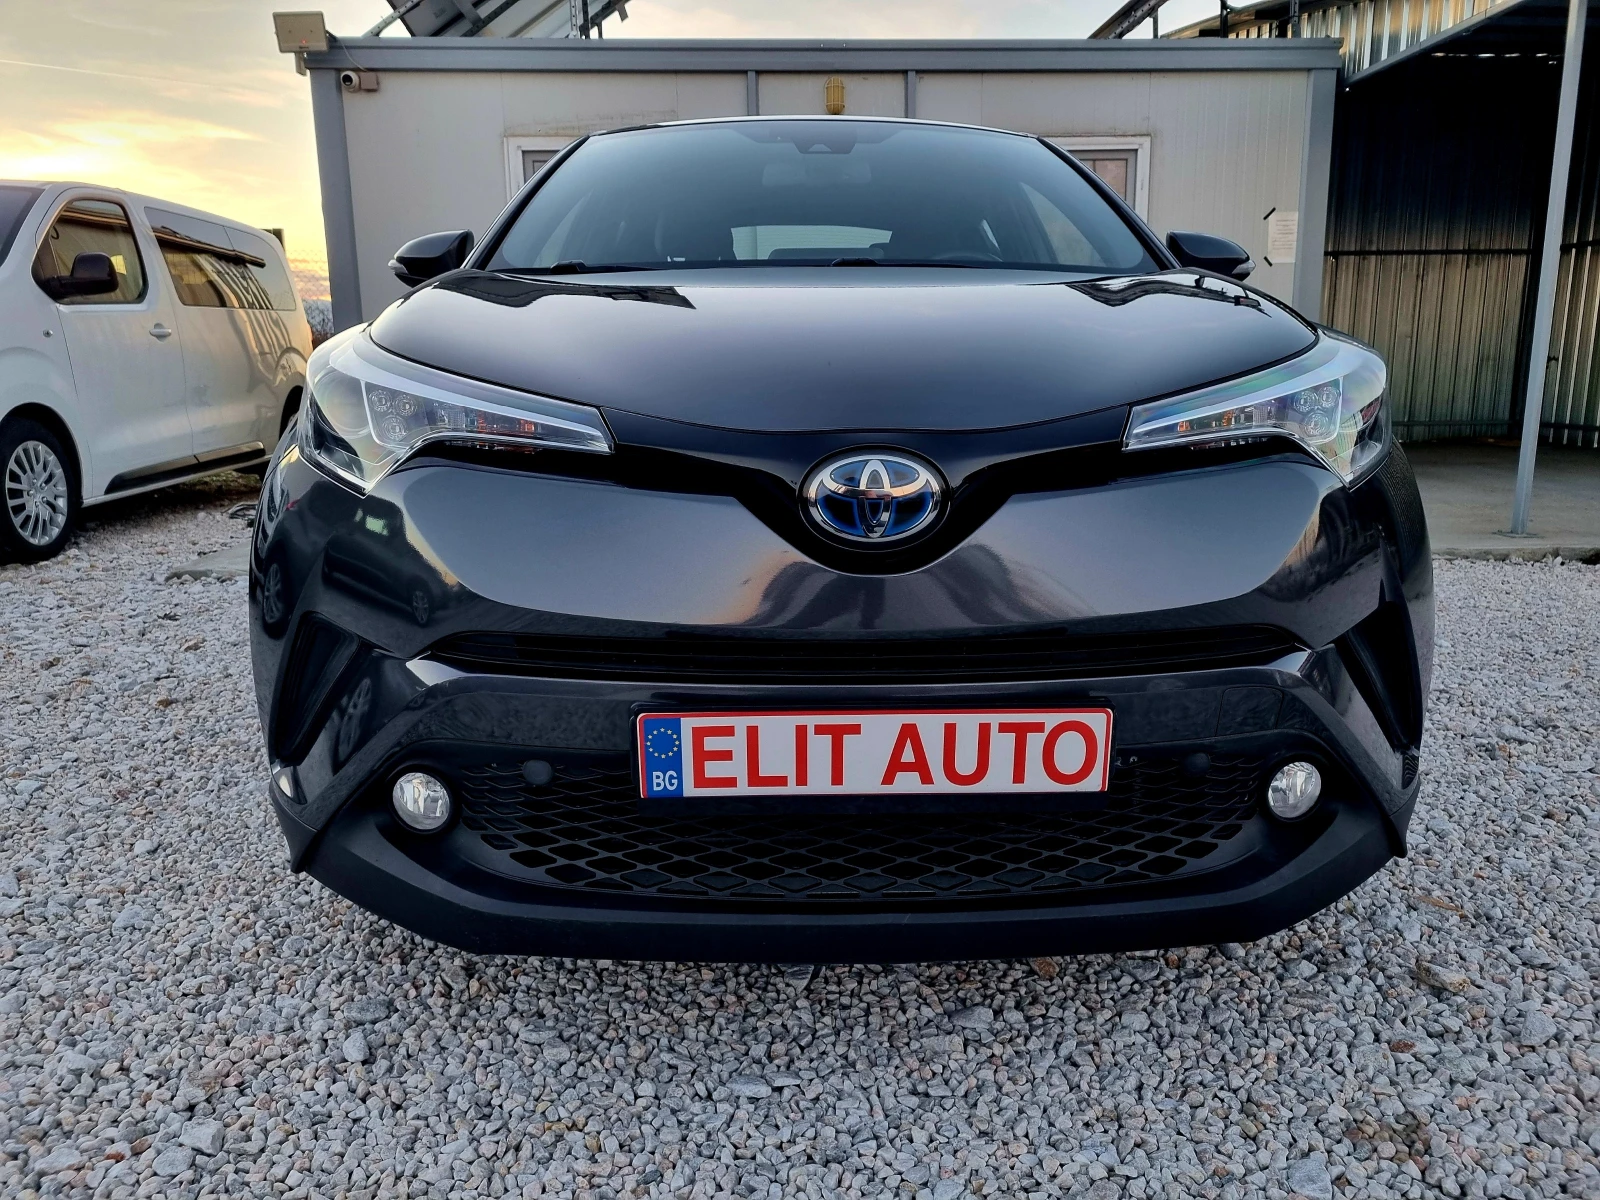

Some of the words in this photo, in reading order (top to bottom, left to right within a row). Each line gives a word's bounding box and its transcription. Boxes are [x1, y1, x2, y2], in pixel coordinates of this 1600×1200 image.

[692, 724, 862, 788] ELIT
[881, 720, 1099, 786] AUTO
[652, 771, 678, 791] BG
